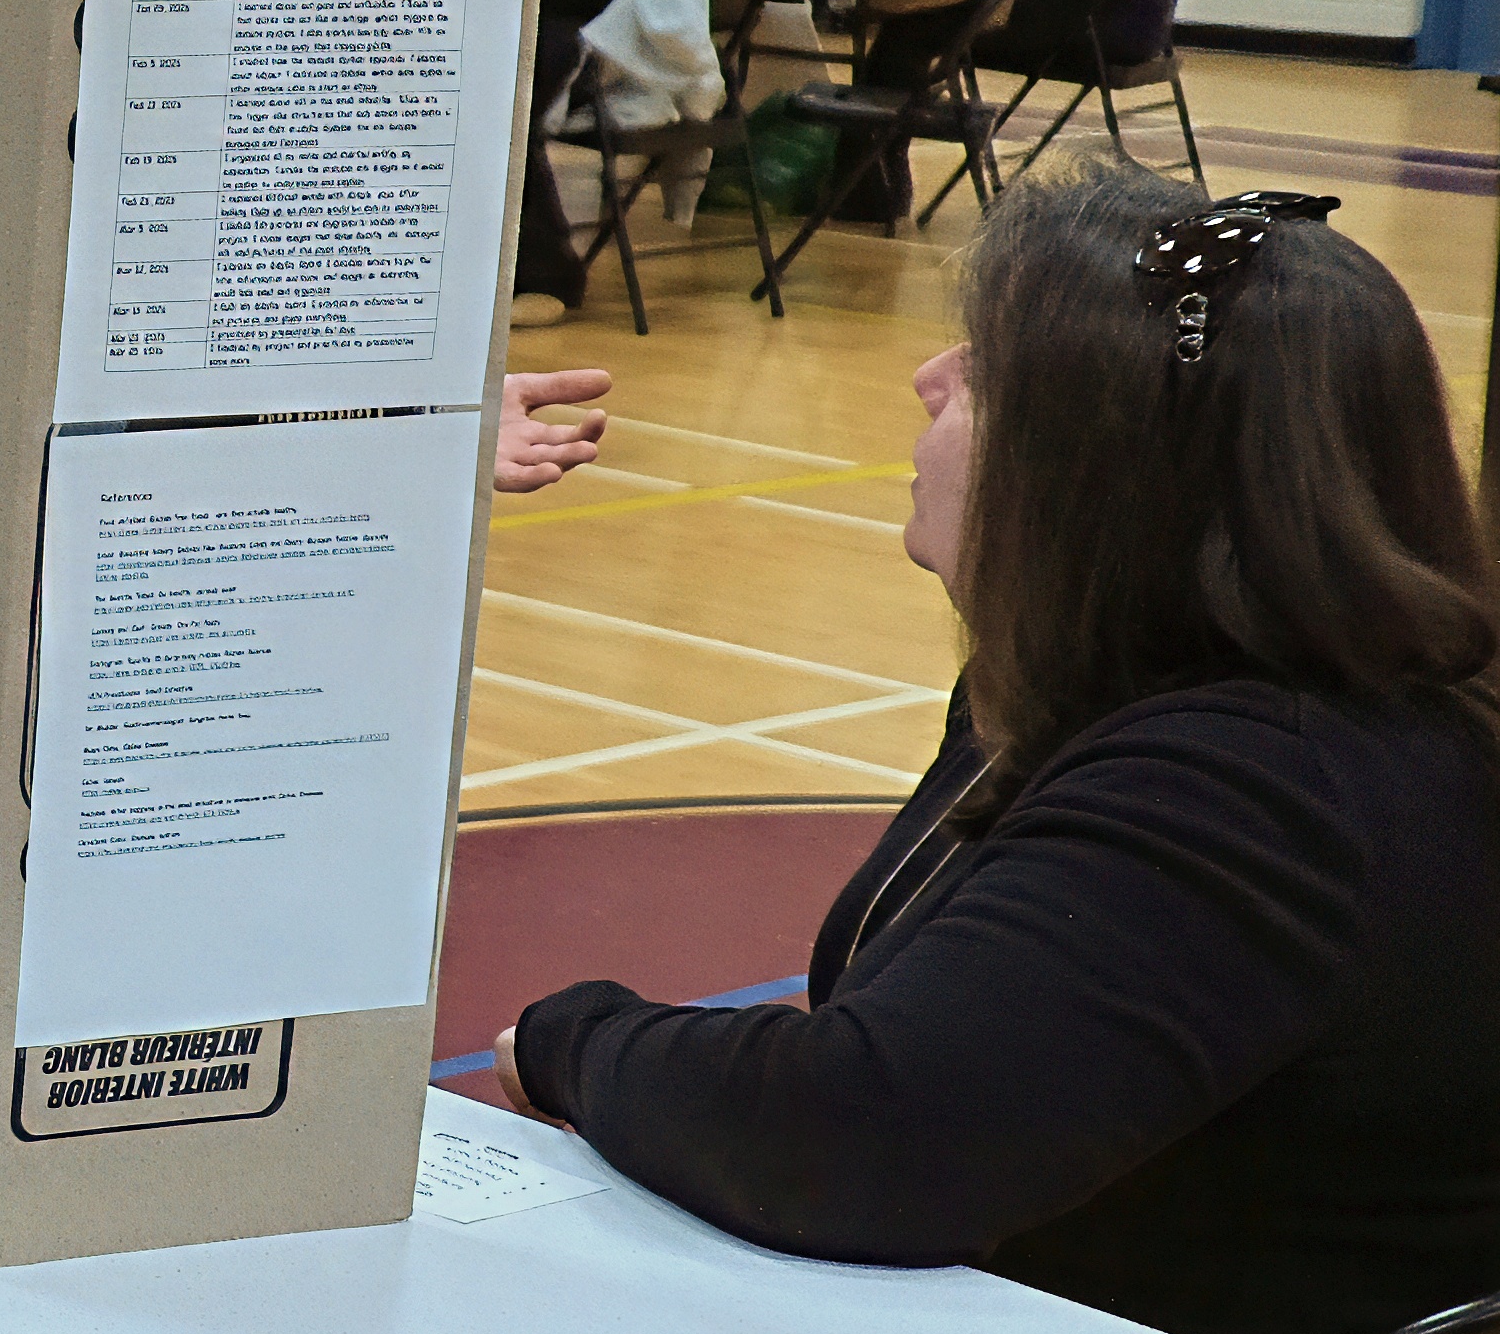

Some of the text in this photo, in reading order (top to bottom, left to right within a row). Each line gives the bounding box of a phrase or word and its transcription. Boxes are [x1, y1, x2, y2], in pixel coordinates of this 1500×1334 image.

[41, 1039, 129, 1075] BLANC
[46, 1062, 250, 1109] WHITE INTERIOR
